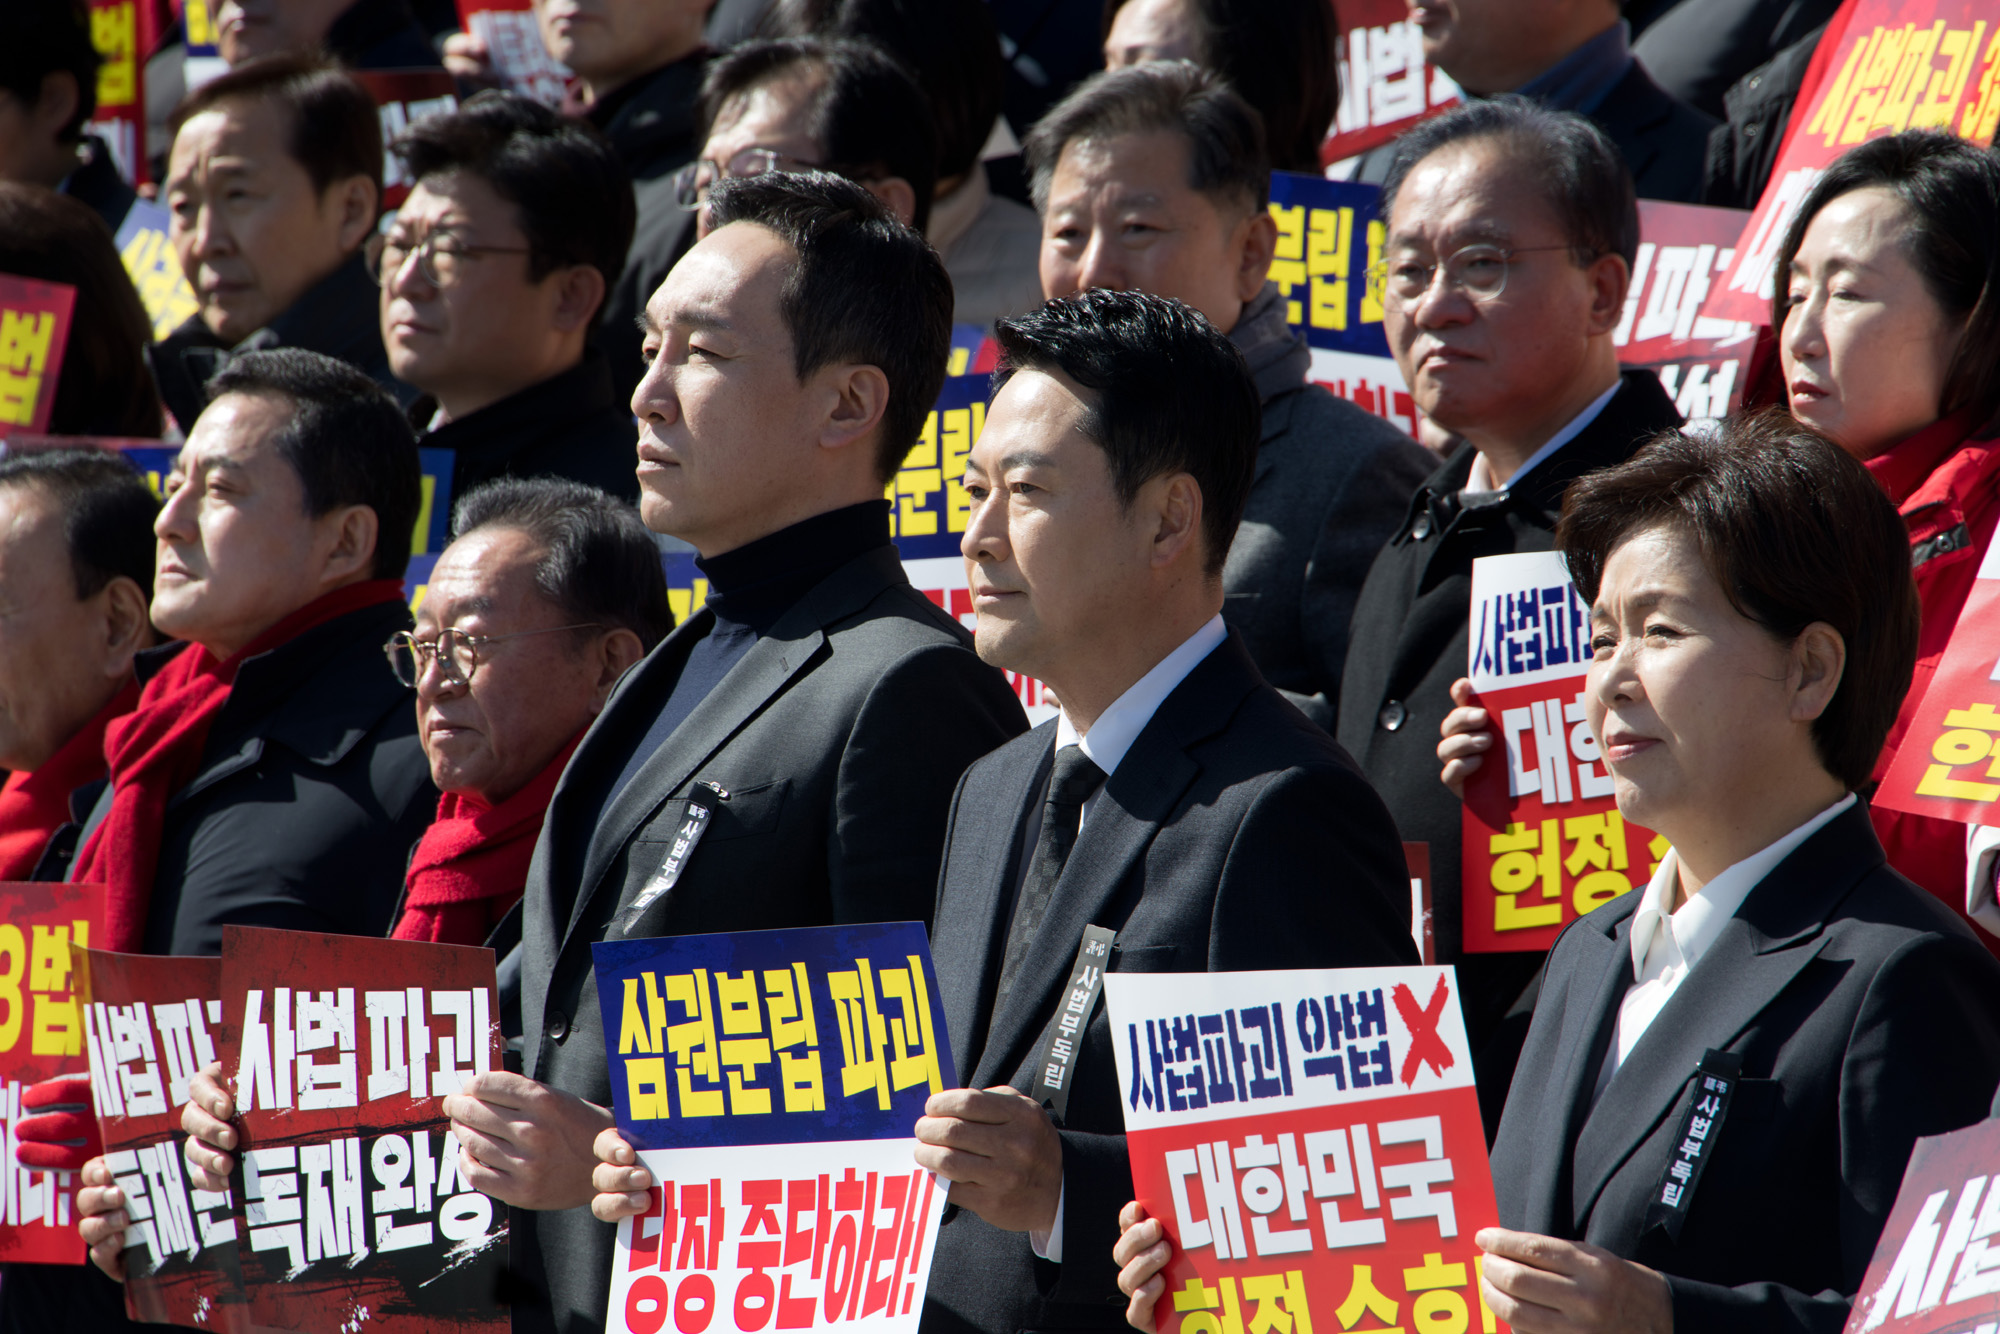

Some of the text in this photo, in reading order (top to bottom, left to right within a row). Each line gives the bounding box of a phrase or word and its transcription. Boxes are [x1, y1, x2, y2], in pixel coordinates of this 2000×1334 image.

[1806, 19, 1987, 147] 사법파괴
[885, 402, 985, 538] 분립
[1473, 583, 1593, 676] 사법파
[152, 998, 222, 1108] 파
[236, 987, 491, 1113] 사법 파괴
[618, 955, 944, 1121] 삼권분립 파괴
[1043, 965, 1099, 1091] 사법부독립
[1128, 988, 1394, 1114] 사법파괴 악법
[242, 1137, 366, 1272] 독재
[1164, 1115, 1458, 1260] 대한민국
[1660, 1094, 1721, 1208] 사법부독립
[624, 1166, 937, 1334] 당장 중단하라!
